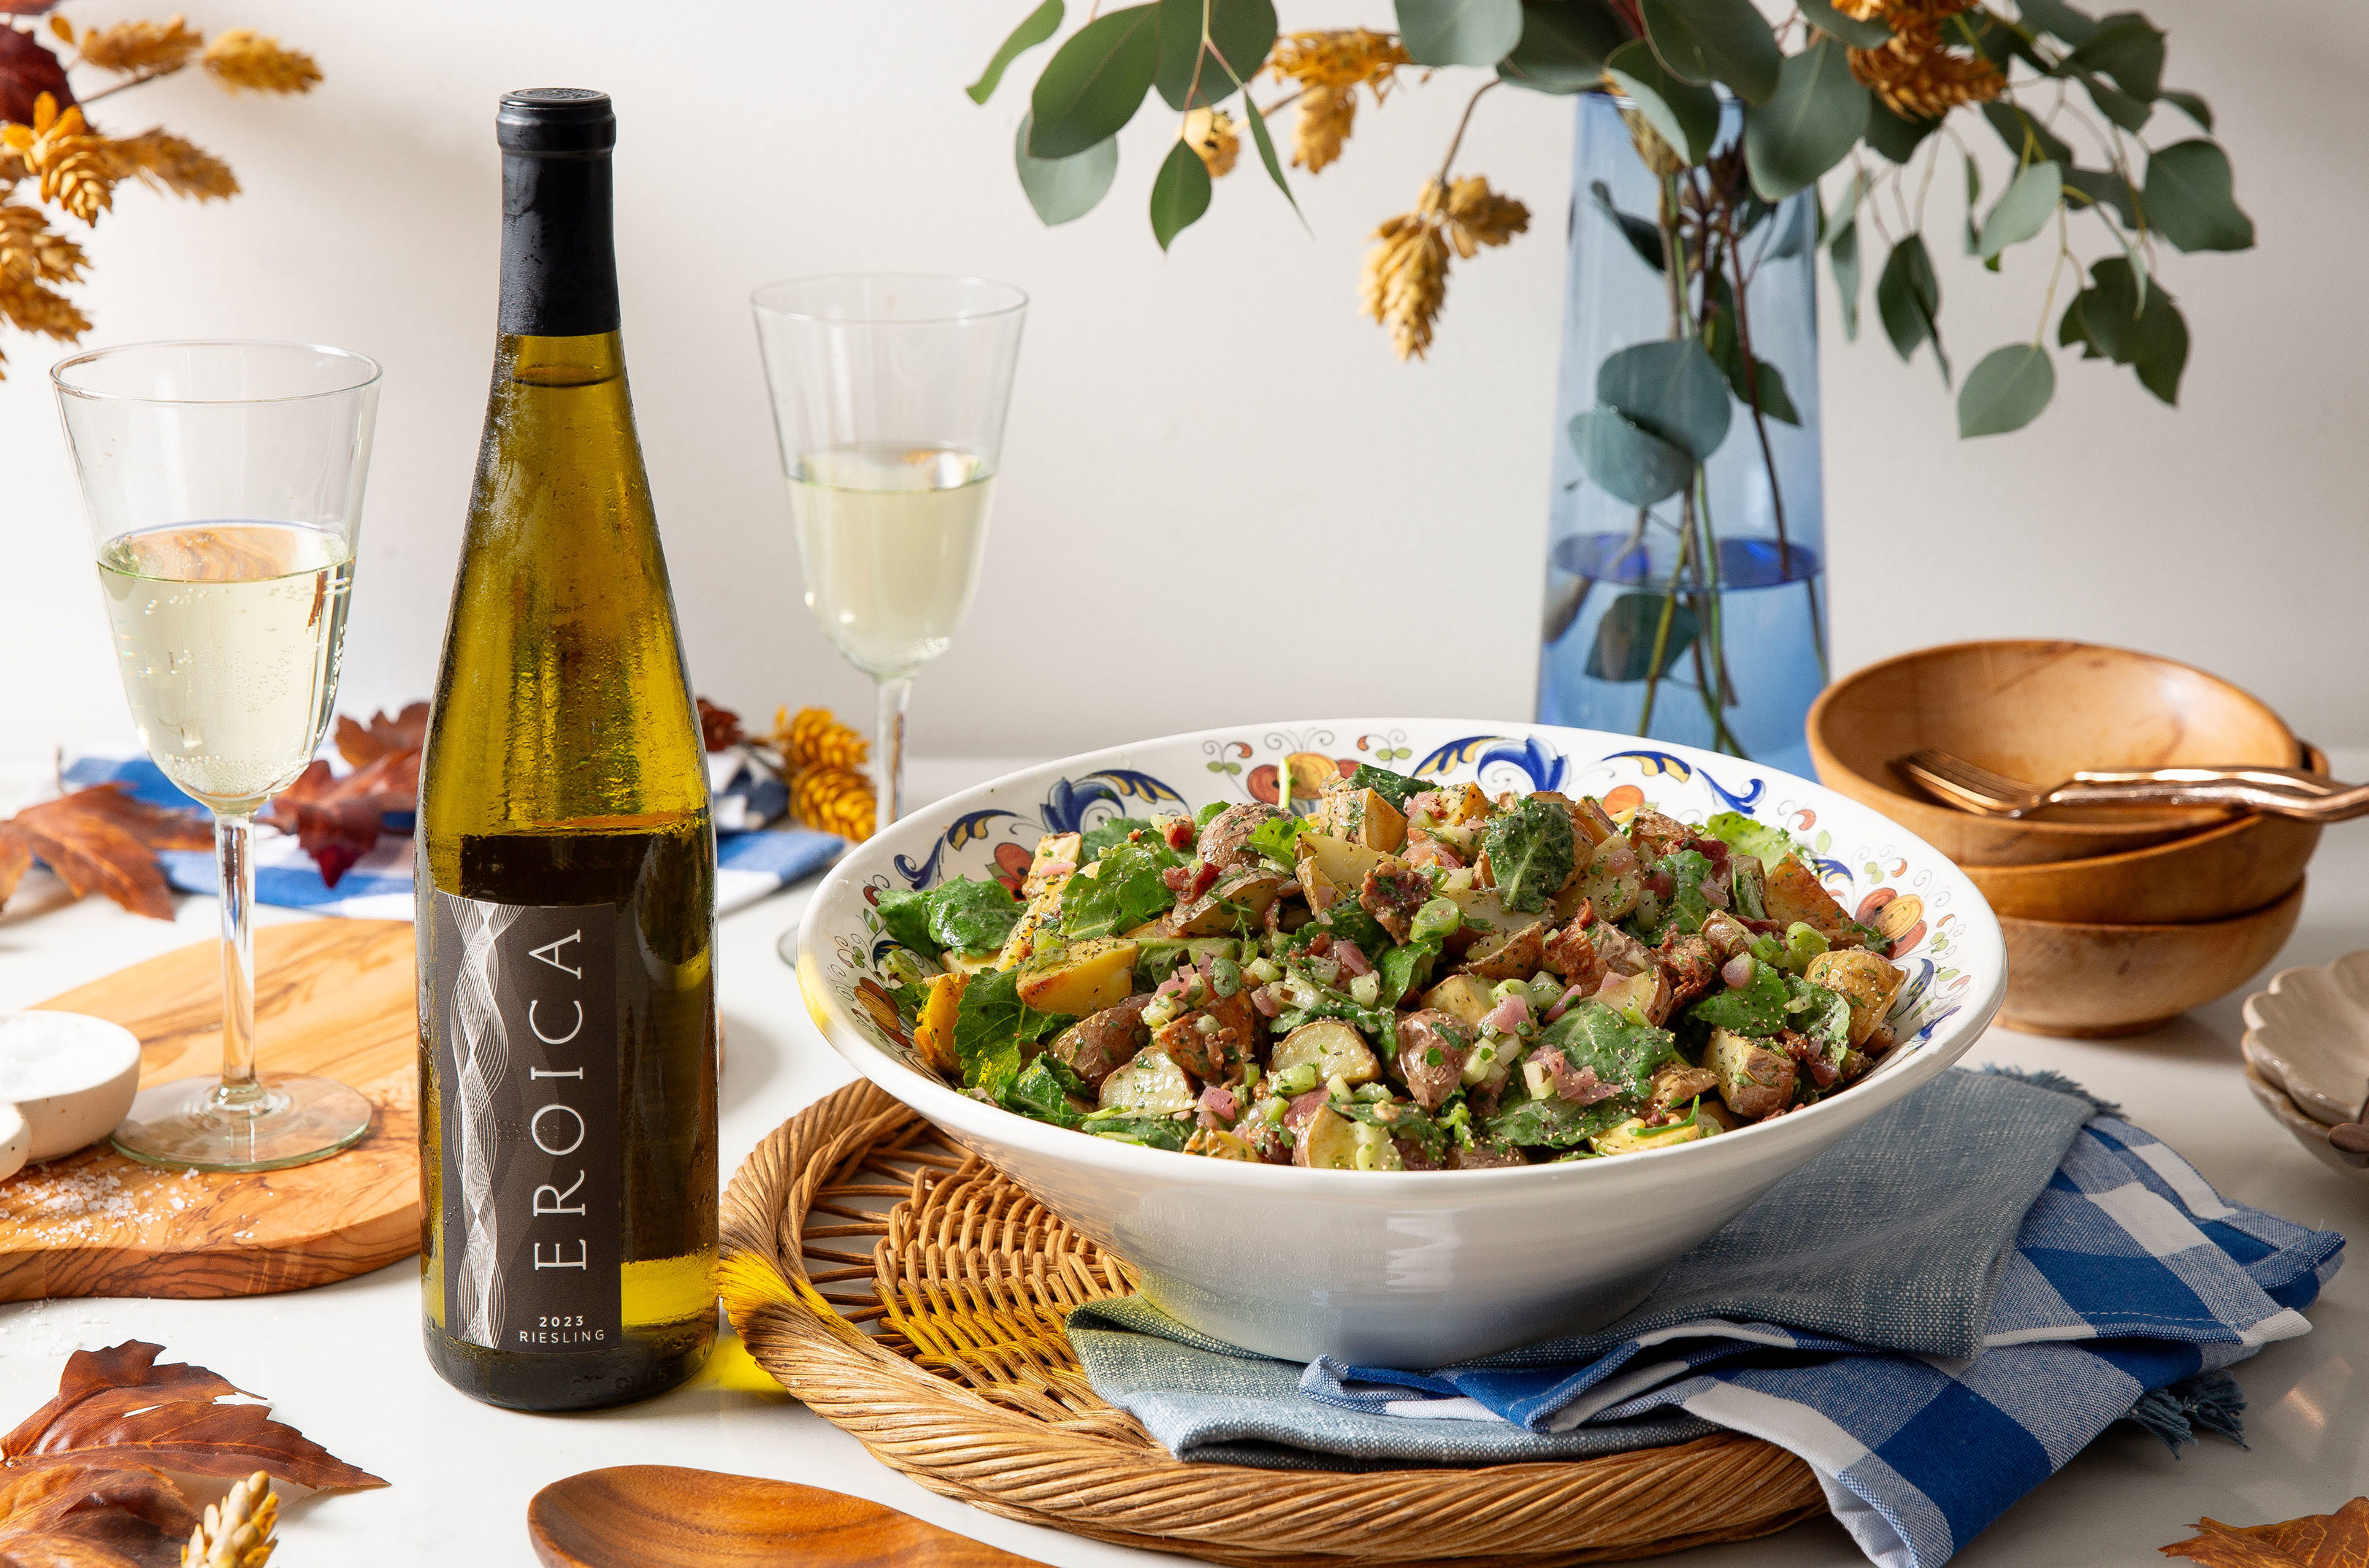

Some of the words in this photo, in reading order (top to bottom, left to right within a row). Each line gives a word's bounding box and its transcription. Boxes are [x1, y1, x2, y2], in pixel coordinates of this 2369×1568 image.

[528, 929, 586, 1271] EROICA
[539, 1315, 583, 1327] 2023
[519, 1329, 605, 1343] RIESLING
